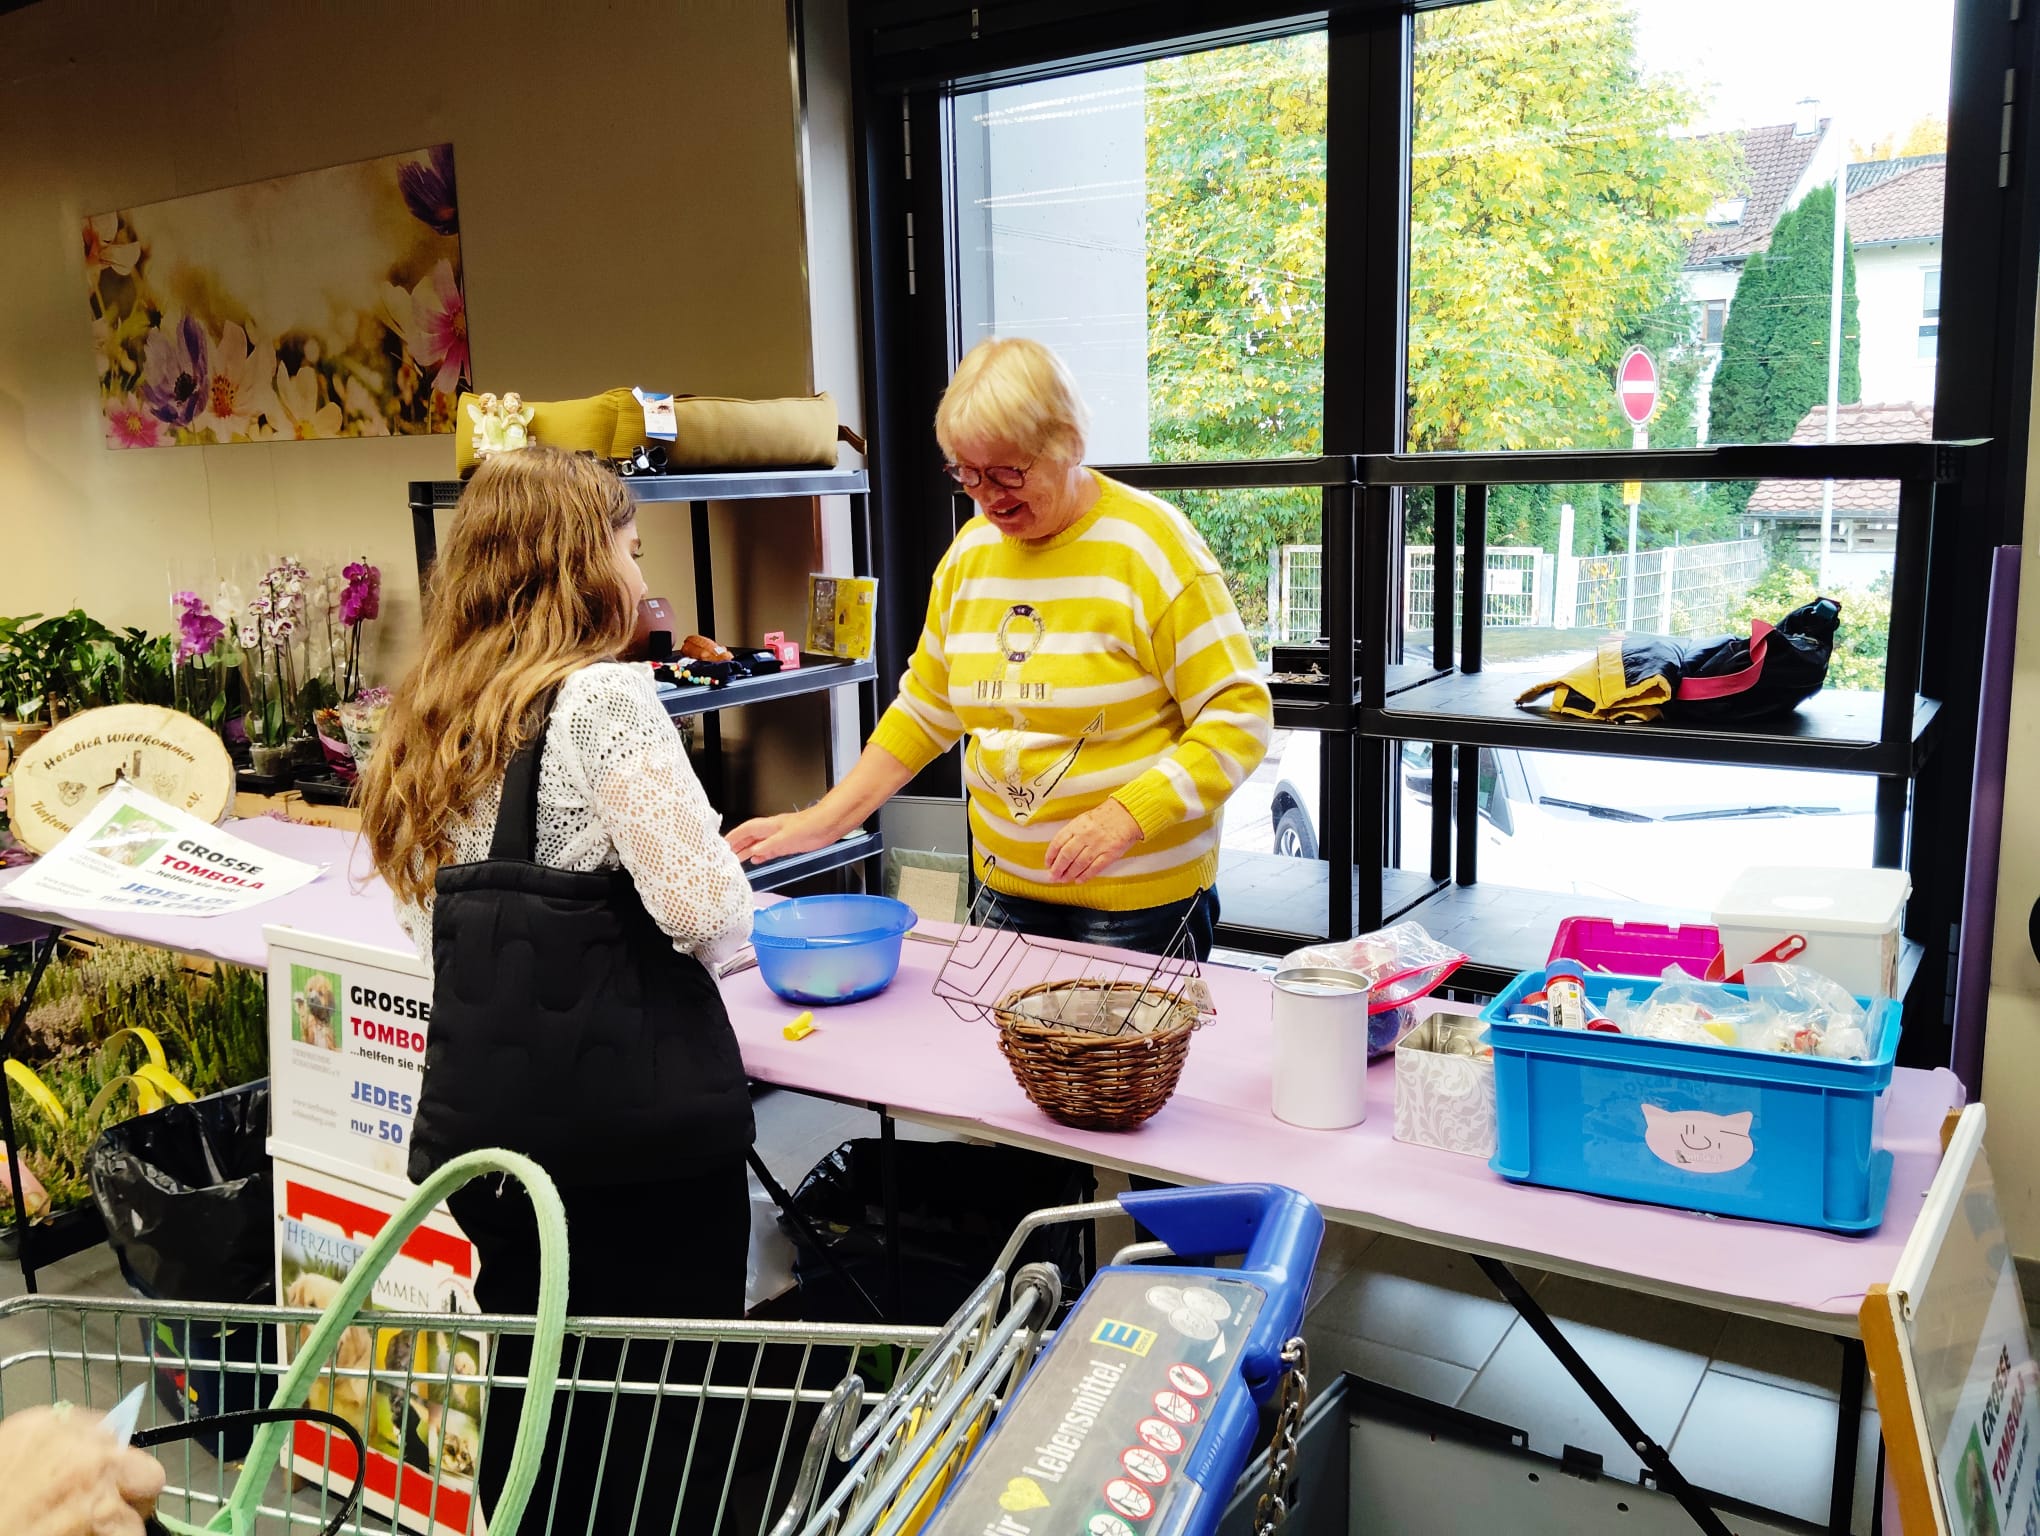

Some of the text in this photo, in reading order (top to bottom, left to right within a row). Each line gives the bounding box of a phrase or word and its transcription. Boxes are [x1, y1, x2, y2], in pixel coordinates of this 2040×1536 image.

[43, 732, 196, 770] Herzlich Willkommen
[30, 800, 74, 833] Tierfreu
[161, 854, 265, 889] TOMBOLA
[177, 839, 264, 875] GROSSE
[119, 882, 239, 906] JEDES LOS
[131, 898, 161, 906] 50
[162, 902, 226, 912] CENT
[350, 985, 430, 1021] GROSSE
[350, 1017, 425, 1053] TOMBO
[397, 1058, 414, 1070] sie
[351, 1080, 412, 1115] JEDES
[350, 1119, 403, 1144] nur 50
[286, 1221, 364, 1264] HERZLICH
[1022, 1359, 1127, 1483] Lebensmittel.
[983, 1514, 1031, 1536] ir
